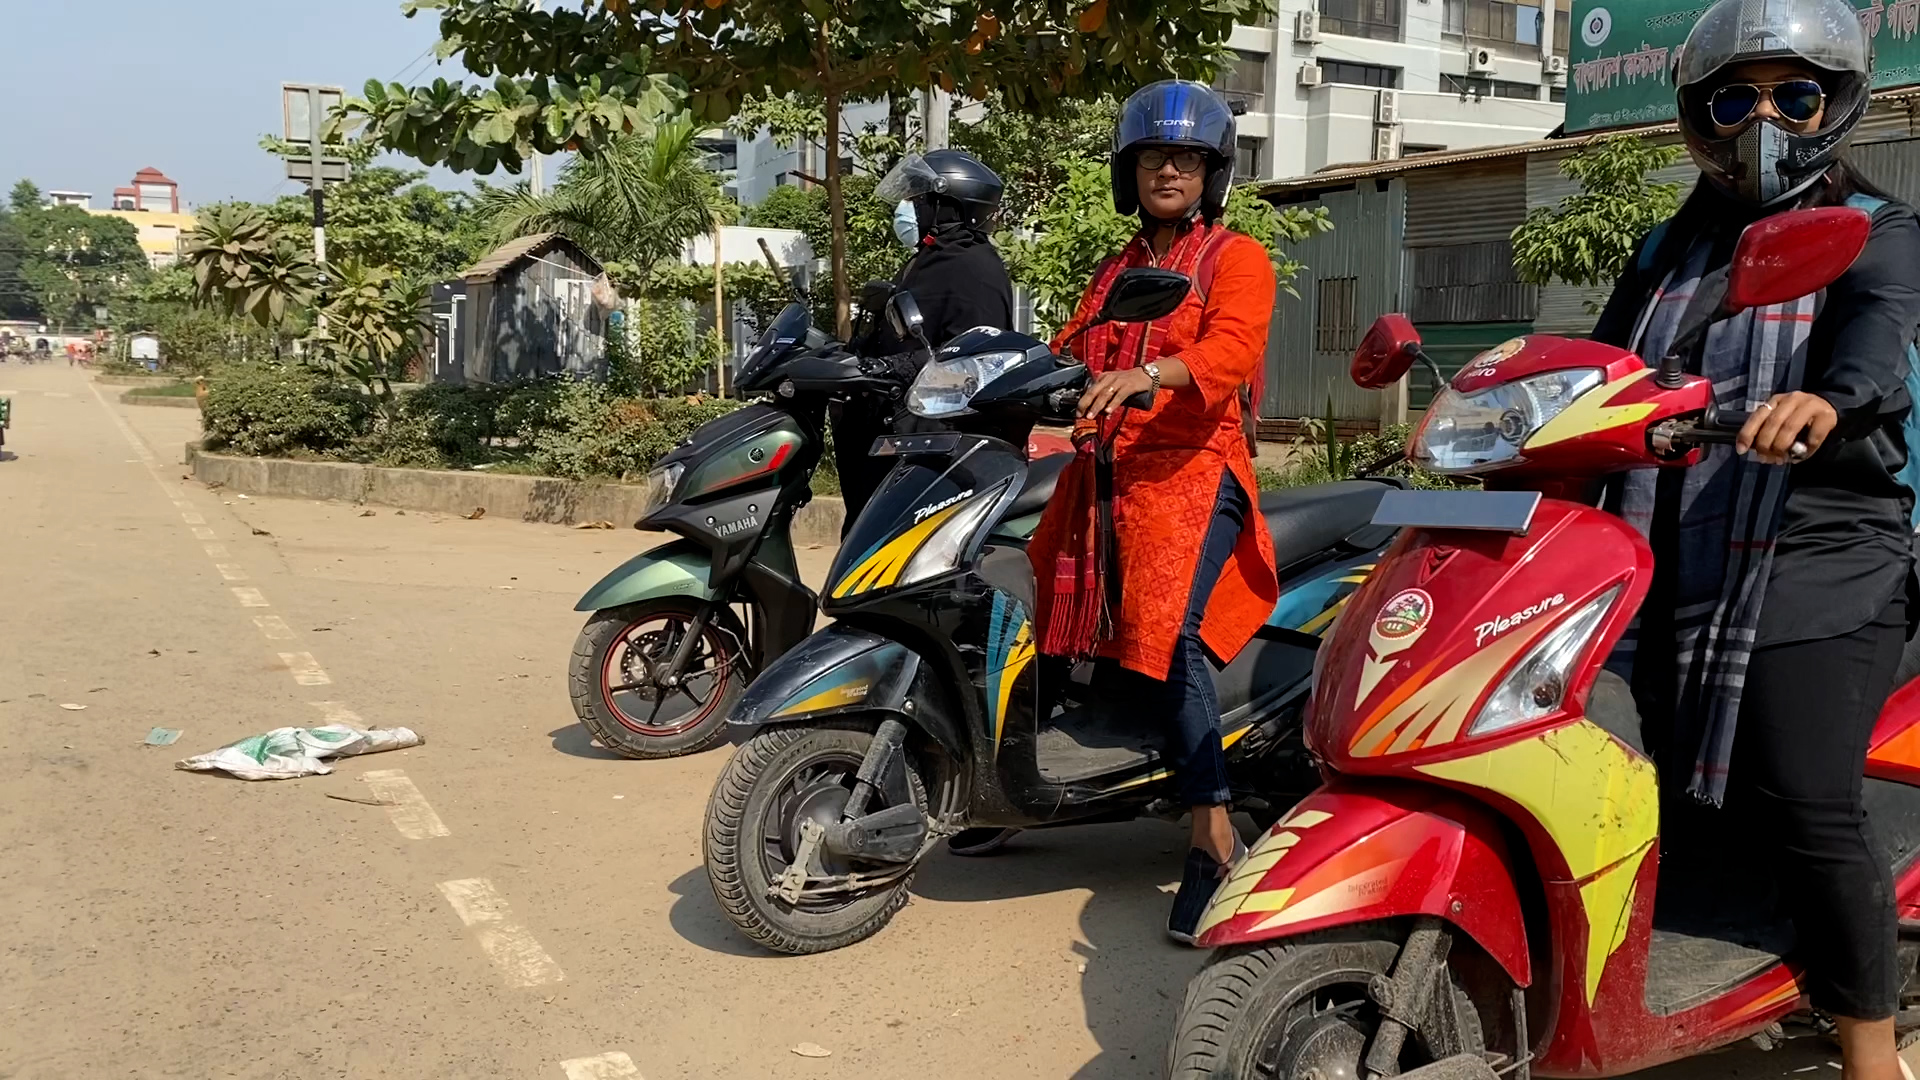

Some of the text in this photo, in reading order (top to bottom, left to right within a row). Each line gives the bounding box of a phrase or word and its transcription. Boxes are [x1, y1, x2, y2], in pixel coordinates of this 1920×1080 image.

[1573, 49, 1622, 94] বাংলাদেশ
[714, 515, 758, 538] YAMAHA
[914, 489, 974, 525] Pleasure
[1473, 592, 1565, 648] Pleasure
